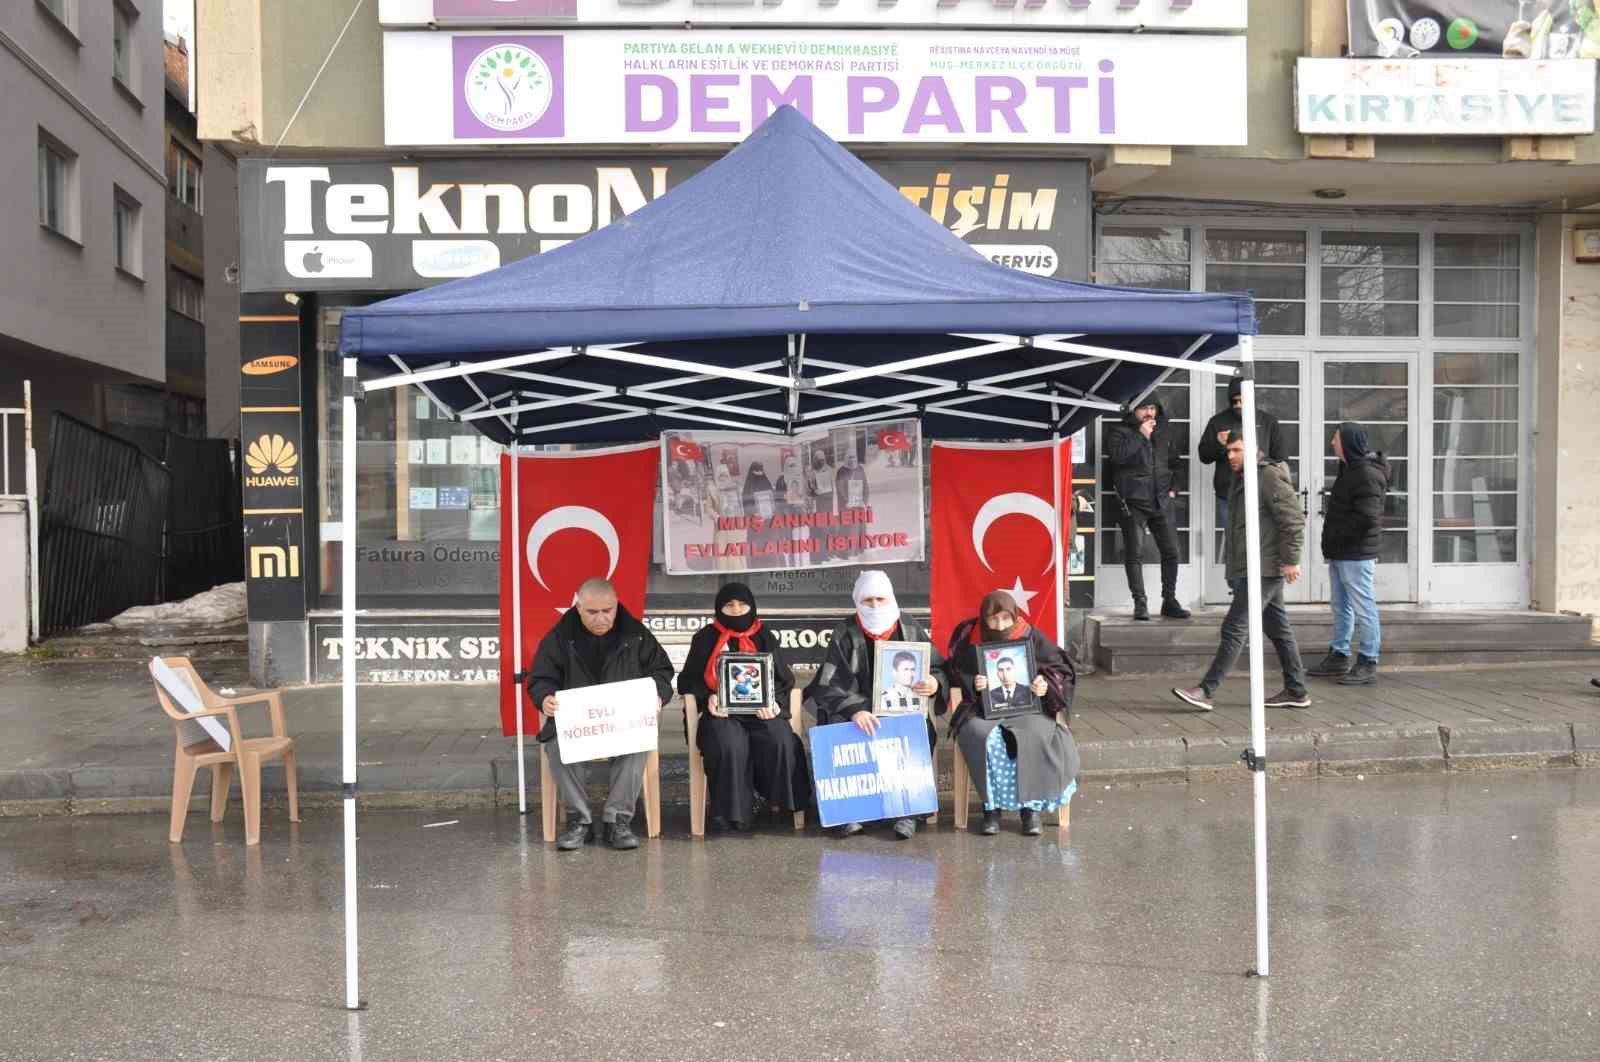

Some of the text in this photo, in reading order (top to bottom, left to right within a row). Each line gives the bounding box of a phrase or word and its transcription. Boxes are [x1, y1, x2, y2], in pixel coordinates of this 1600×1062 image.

[680, 42, 723, 54] GELAN
[624, 58, 698, 71] HALKLARIN
[752, 59, 769, 71] VE
[771, 58, 844, 72] DEMOKRASİ
[850, 58, 899, 73] PARTİSİ
[624, 59, 1116, 135] DEM PARTİ
[246, 476, 299, 488] HUAWEI
[717, 503, 875, 533] MUŞ ANNELERİ
[683, 530, 909, 559] EVLATLARINI İSTİYOR
[355, 546, 425, 562] Fatura
[767, 580, 794, 593] Mp3
[369, 669, 450, 682] TELEFON
[832, 740, 868, 768] ARTIK
